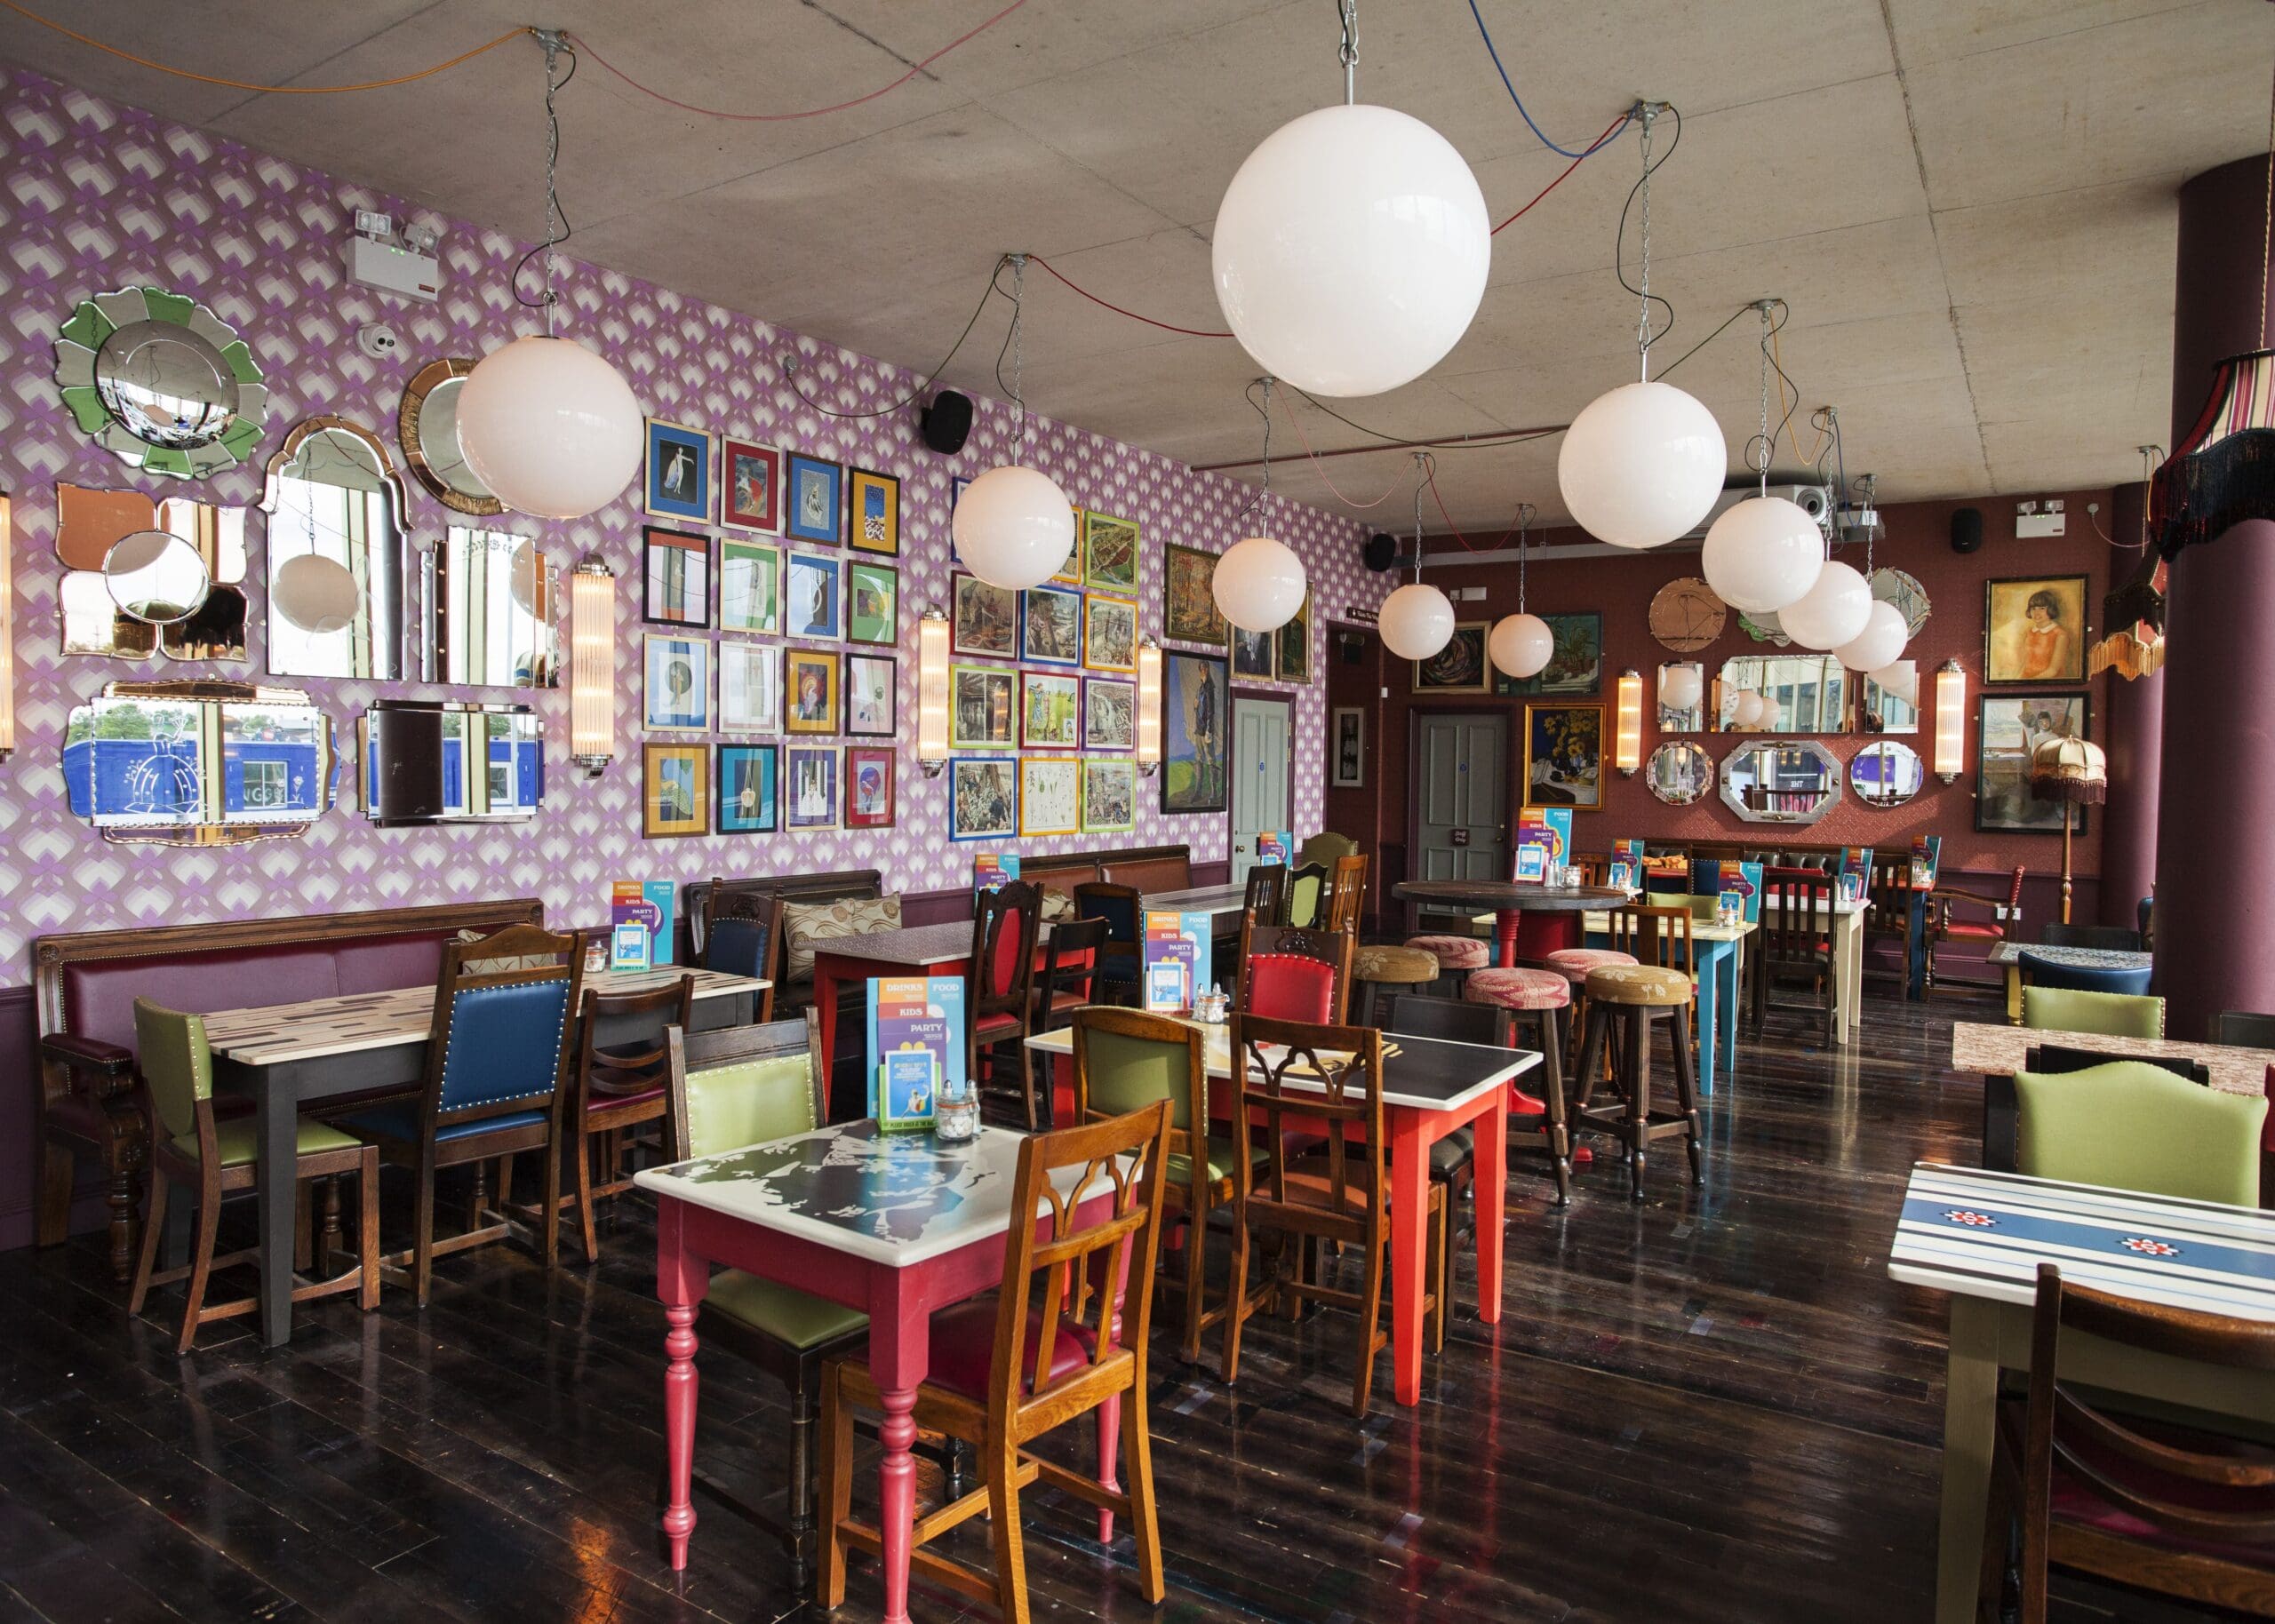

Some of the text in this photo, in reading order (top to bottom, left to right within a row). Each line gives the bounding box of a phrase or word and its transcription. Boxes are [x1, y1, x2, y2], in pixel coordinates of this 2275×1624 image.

[886, 983, 923, 992] DRINKS
[899, 1007, 923, 1016] KIDS
[910, 1023, 943, 1032] PARTY
